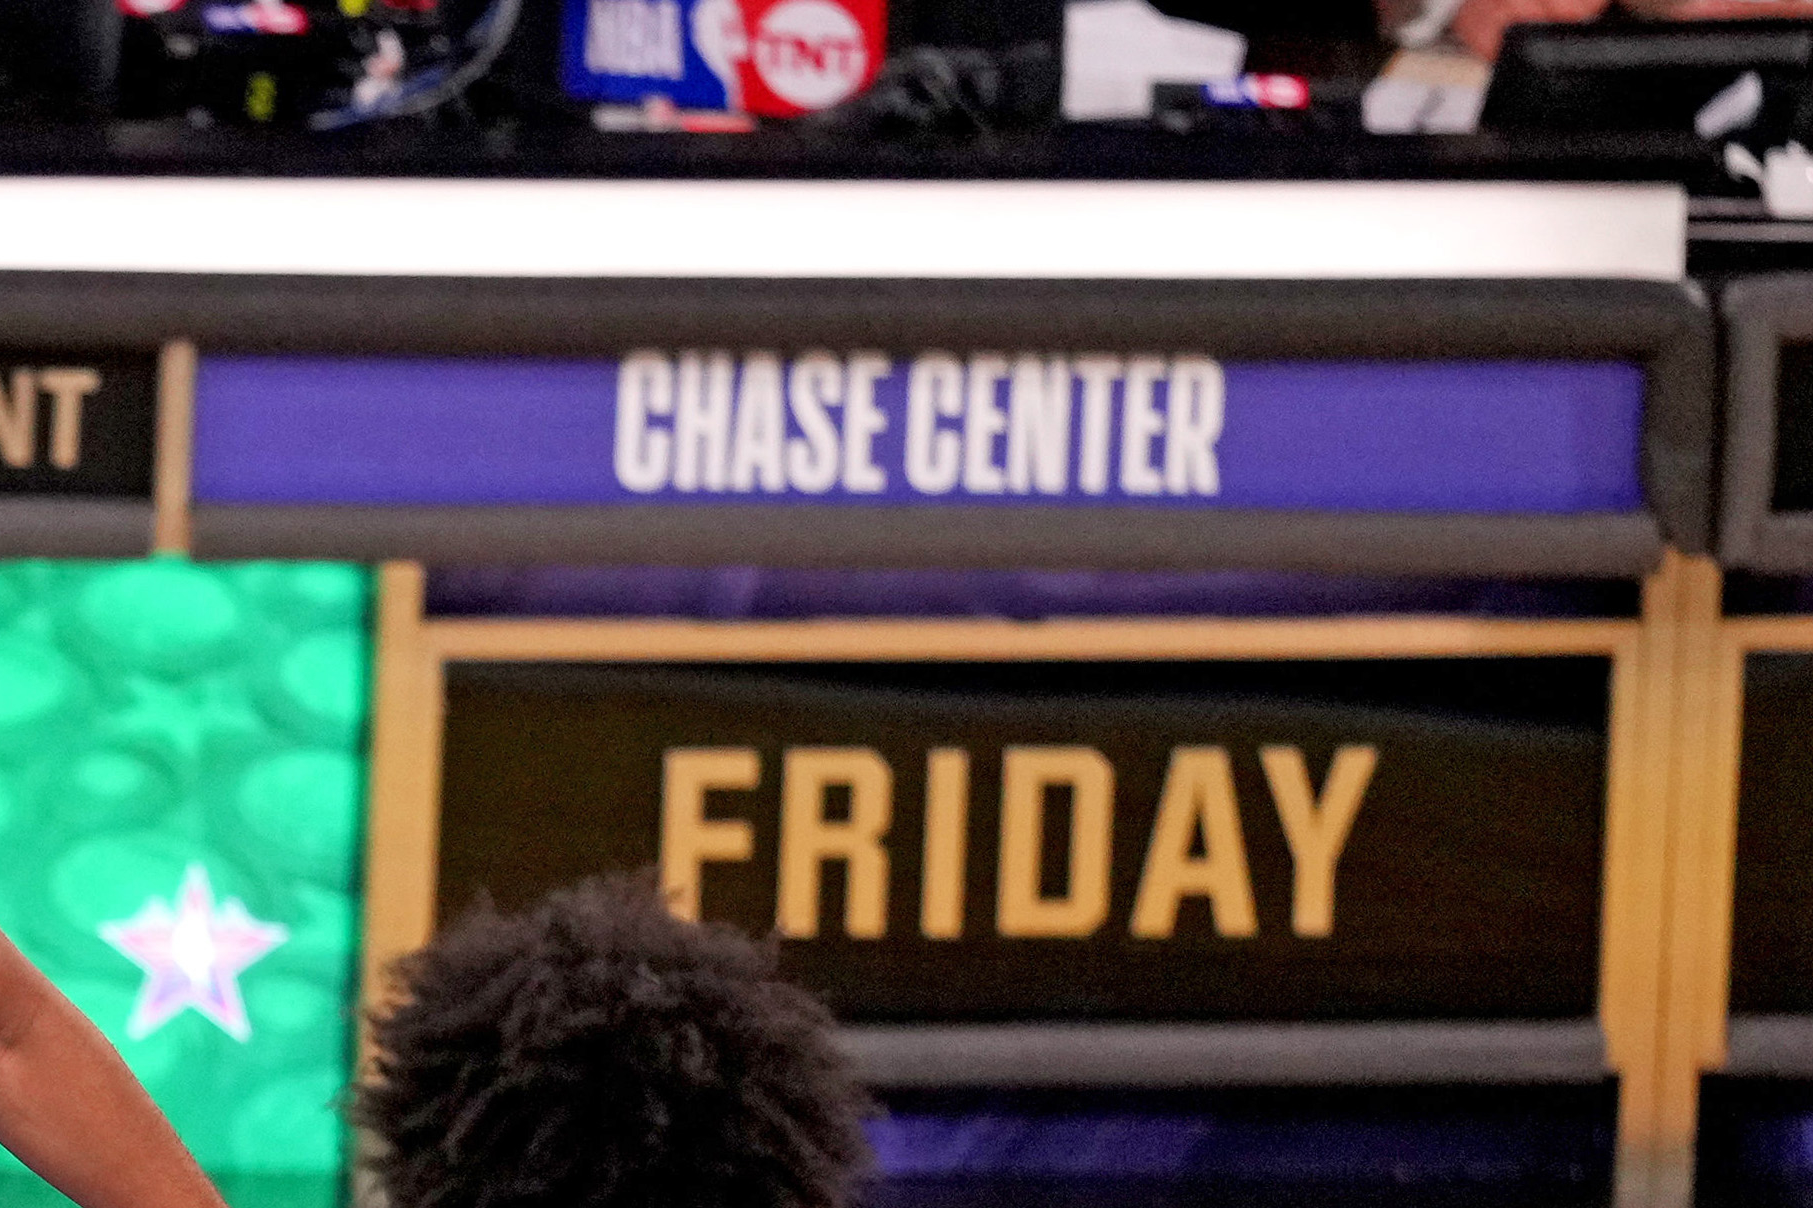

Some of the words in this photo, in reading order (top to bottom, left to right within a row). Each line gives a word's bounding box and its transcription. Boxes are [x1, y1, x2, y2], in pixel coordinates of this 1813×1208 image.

[613, 350, 890, 494] CHASE
[904, 352, 1226, 497] CENTER
[658, 744, 1379, 941] FRIDAY
